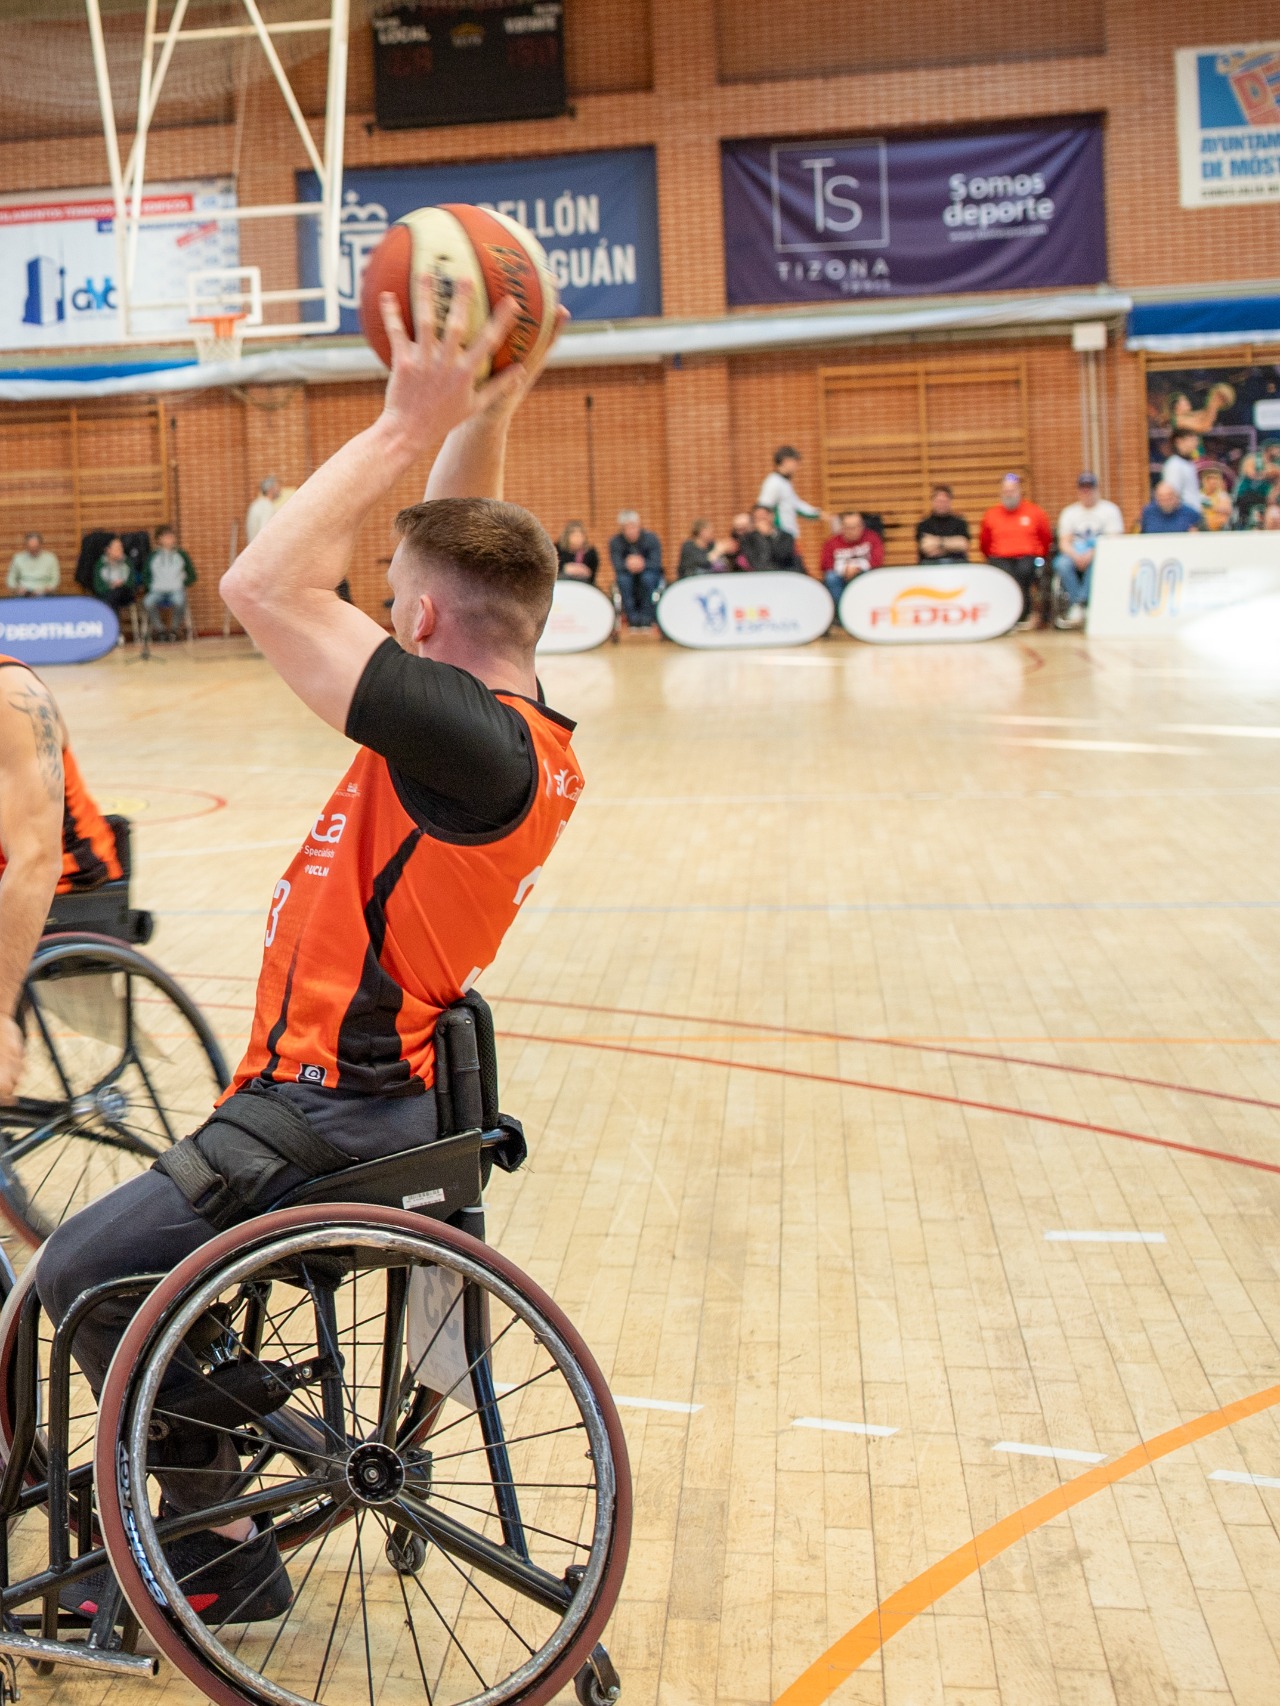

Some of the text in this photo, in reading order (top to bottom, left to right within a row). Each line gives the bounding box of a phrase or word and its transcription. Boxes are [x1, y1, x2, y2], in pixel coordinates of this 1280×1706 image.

[949, 172, 1046, 202] Somos
[942, 196, 1056, 230] deporte
[776, 257, 891, 281] TIZONA
[870, 601, 990, 629] FEDDF
[6, 619, 103, 642] DECATHLON
